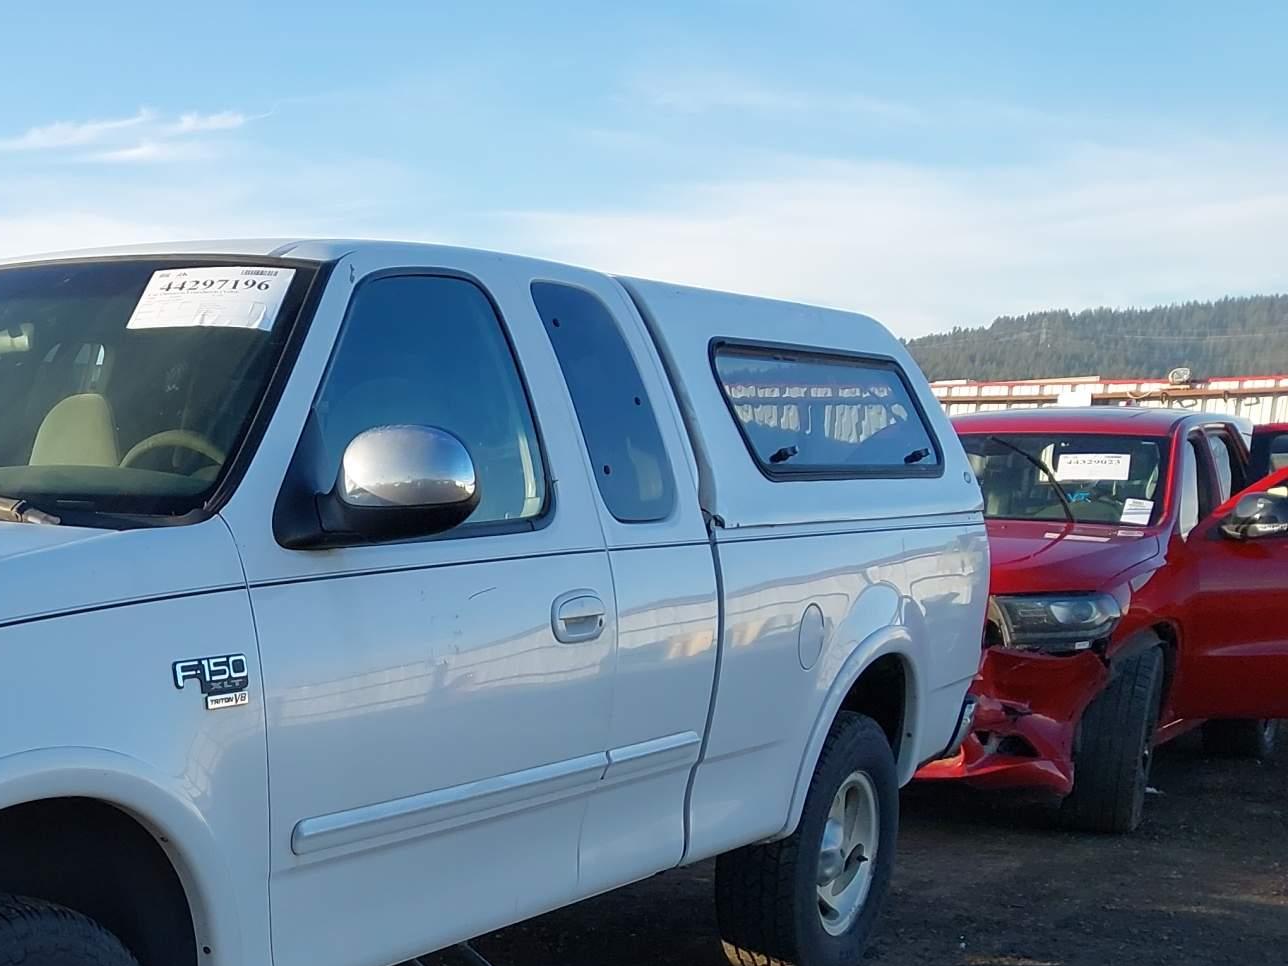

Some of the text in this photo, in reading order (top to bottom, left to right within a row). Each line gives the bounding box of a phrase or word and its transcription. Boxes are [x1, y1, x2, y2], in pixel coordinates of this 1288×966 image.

[160, 279, 273, 291] 44297196
[210, 679, 243, 690] XLT
[210, 693, 247, 705] TRITON V8
